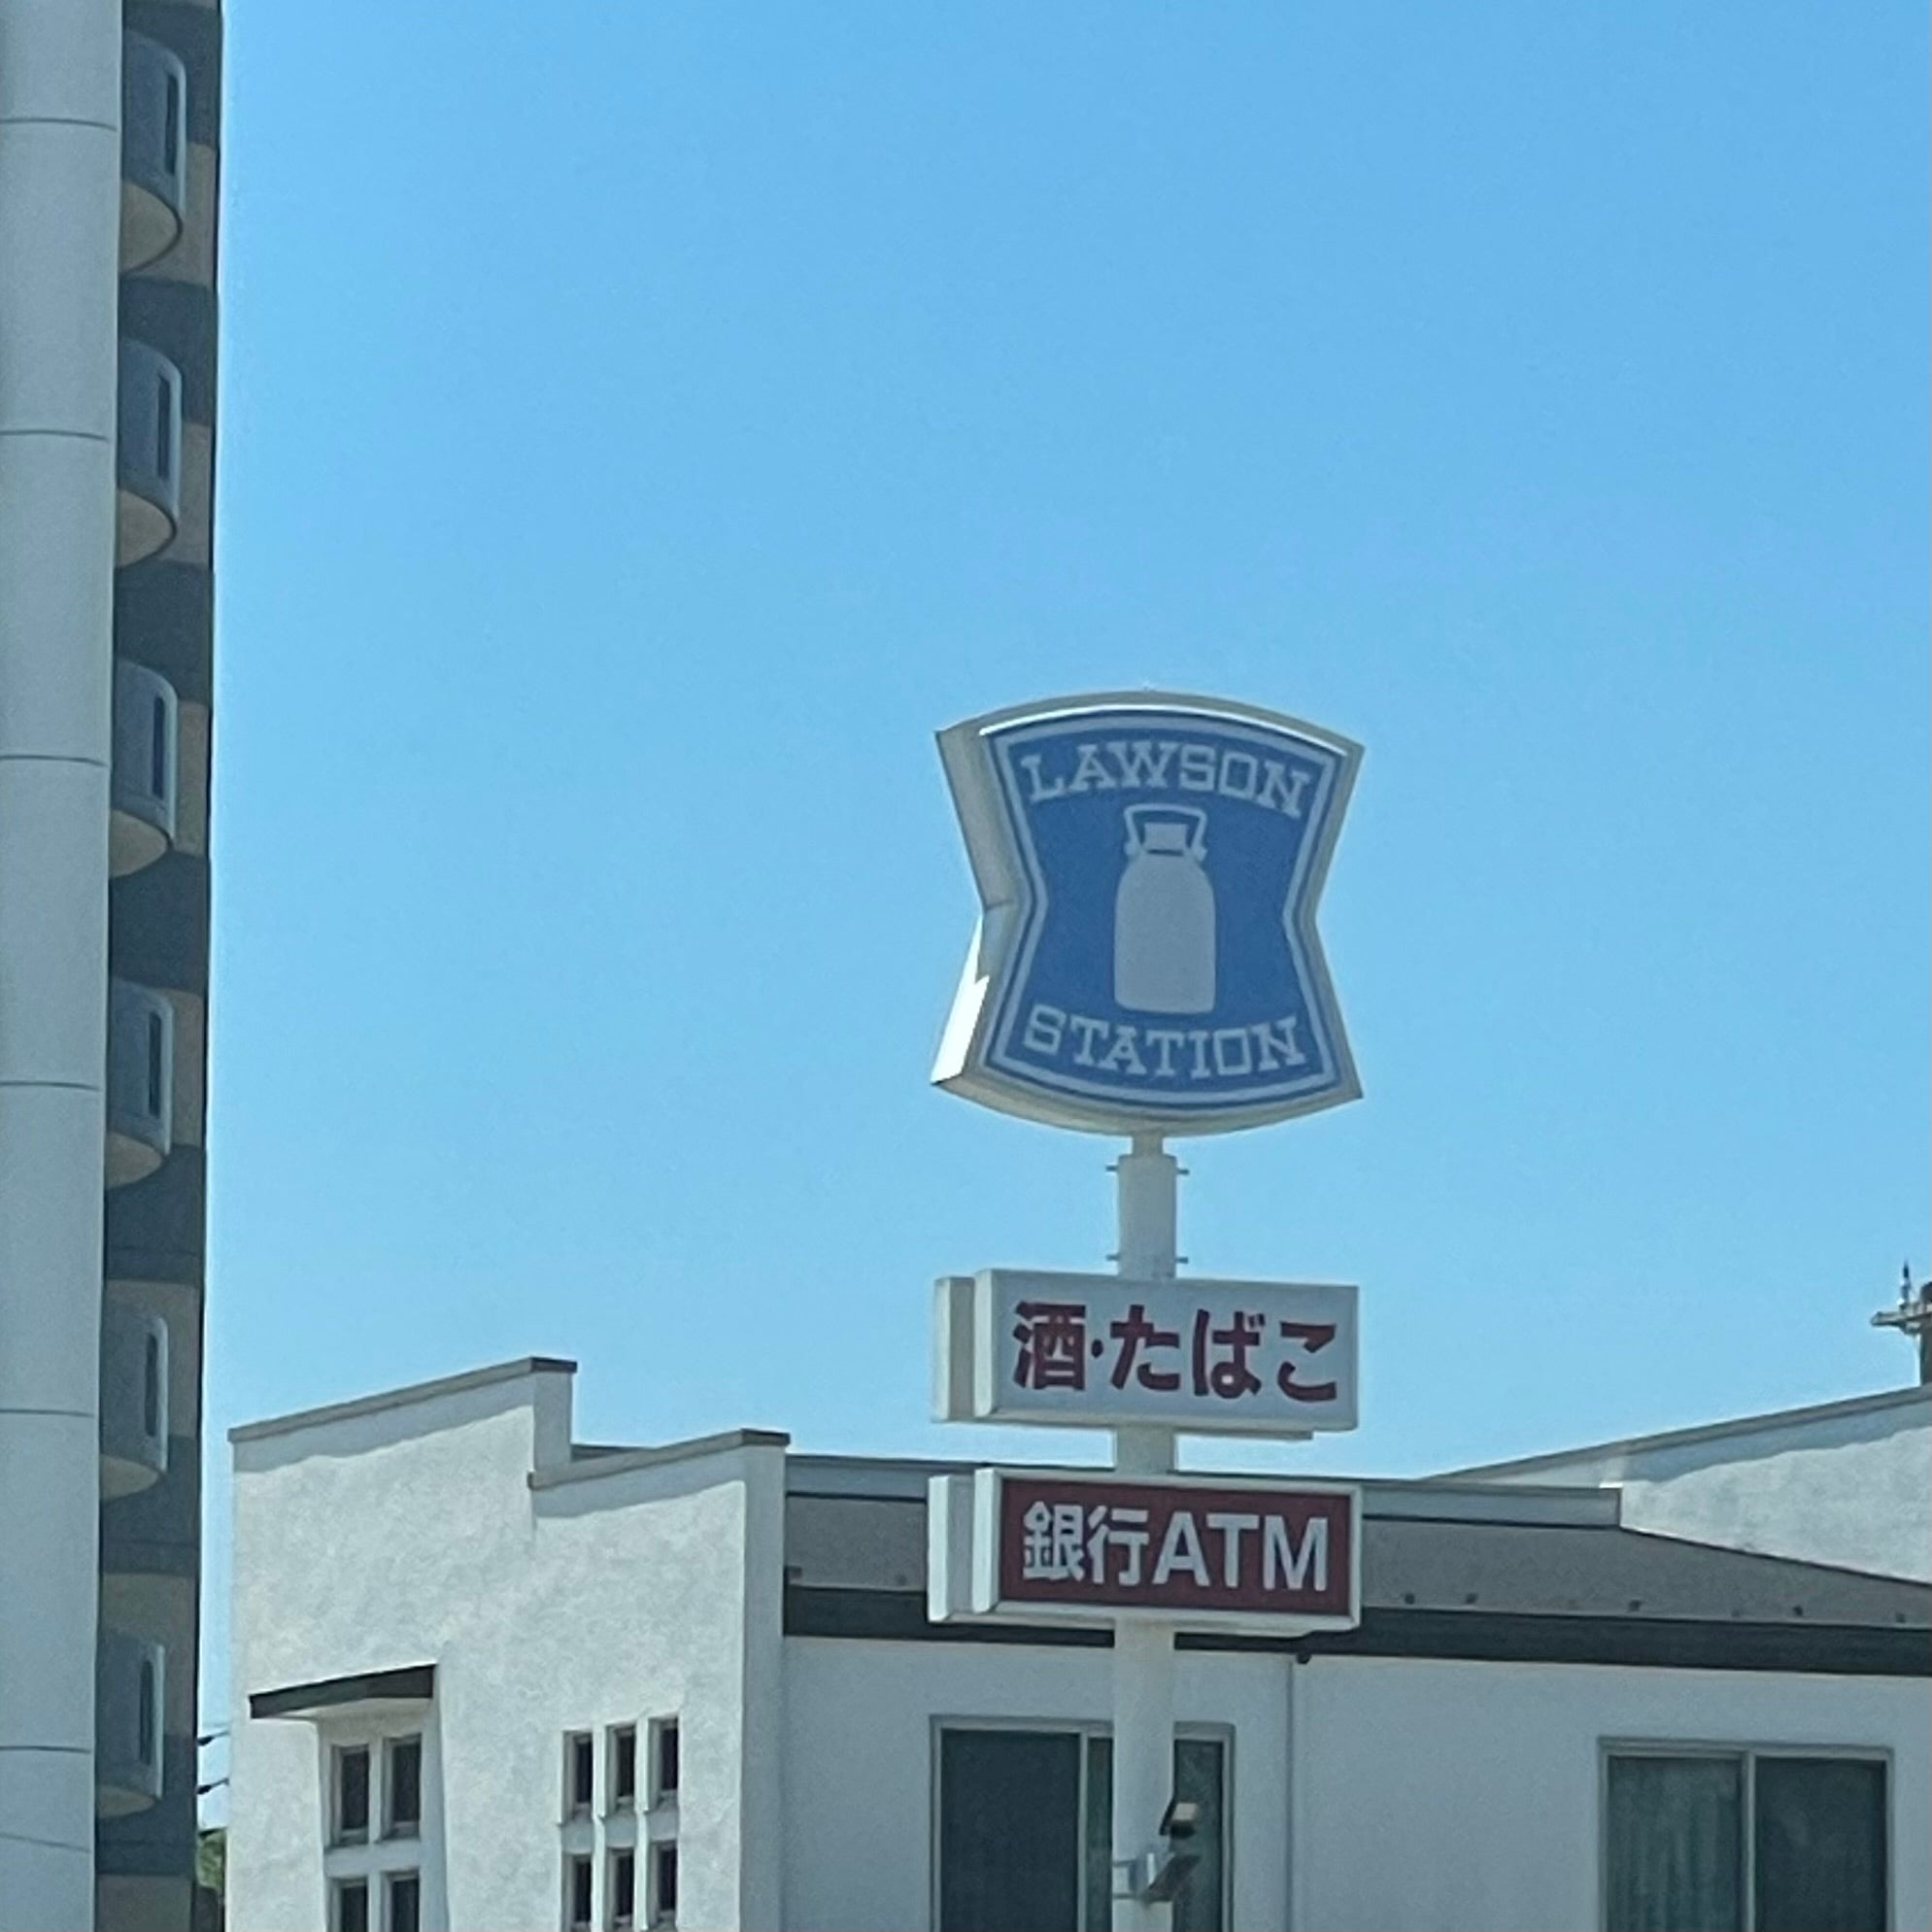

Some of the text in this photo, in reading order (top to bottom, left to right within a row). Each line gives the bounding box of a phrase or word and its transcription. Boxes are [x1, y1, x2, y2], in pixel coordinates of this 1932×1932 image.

[1021, 741, 1313, 819] LAWSON
[1022, 1004, 1305, 1079] STATION
[1012, 1301, 1337, 1402] 酒・たばこ
[1023, 1501, 1328, 1592] 銀行ATM
